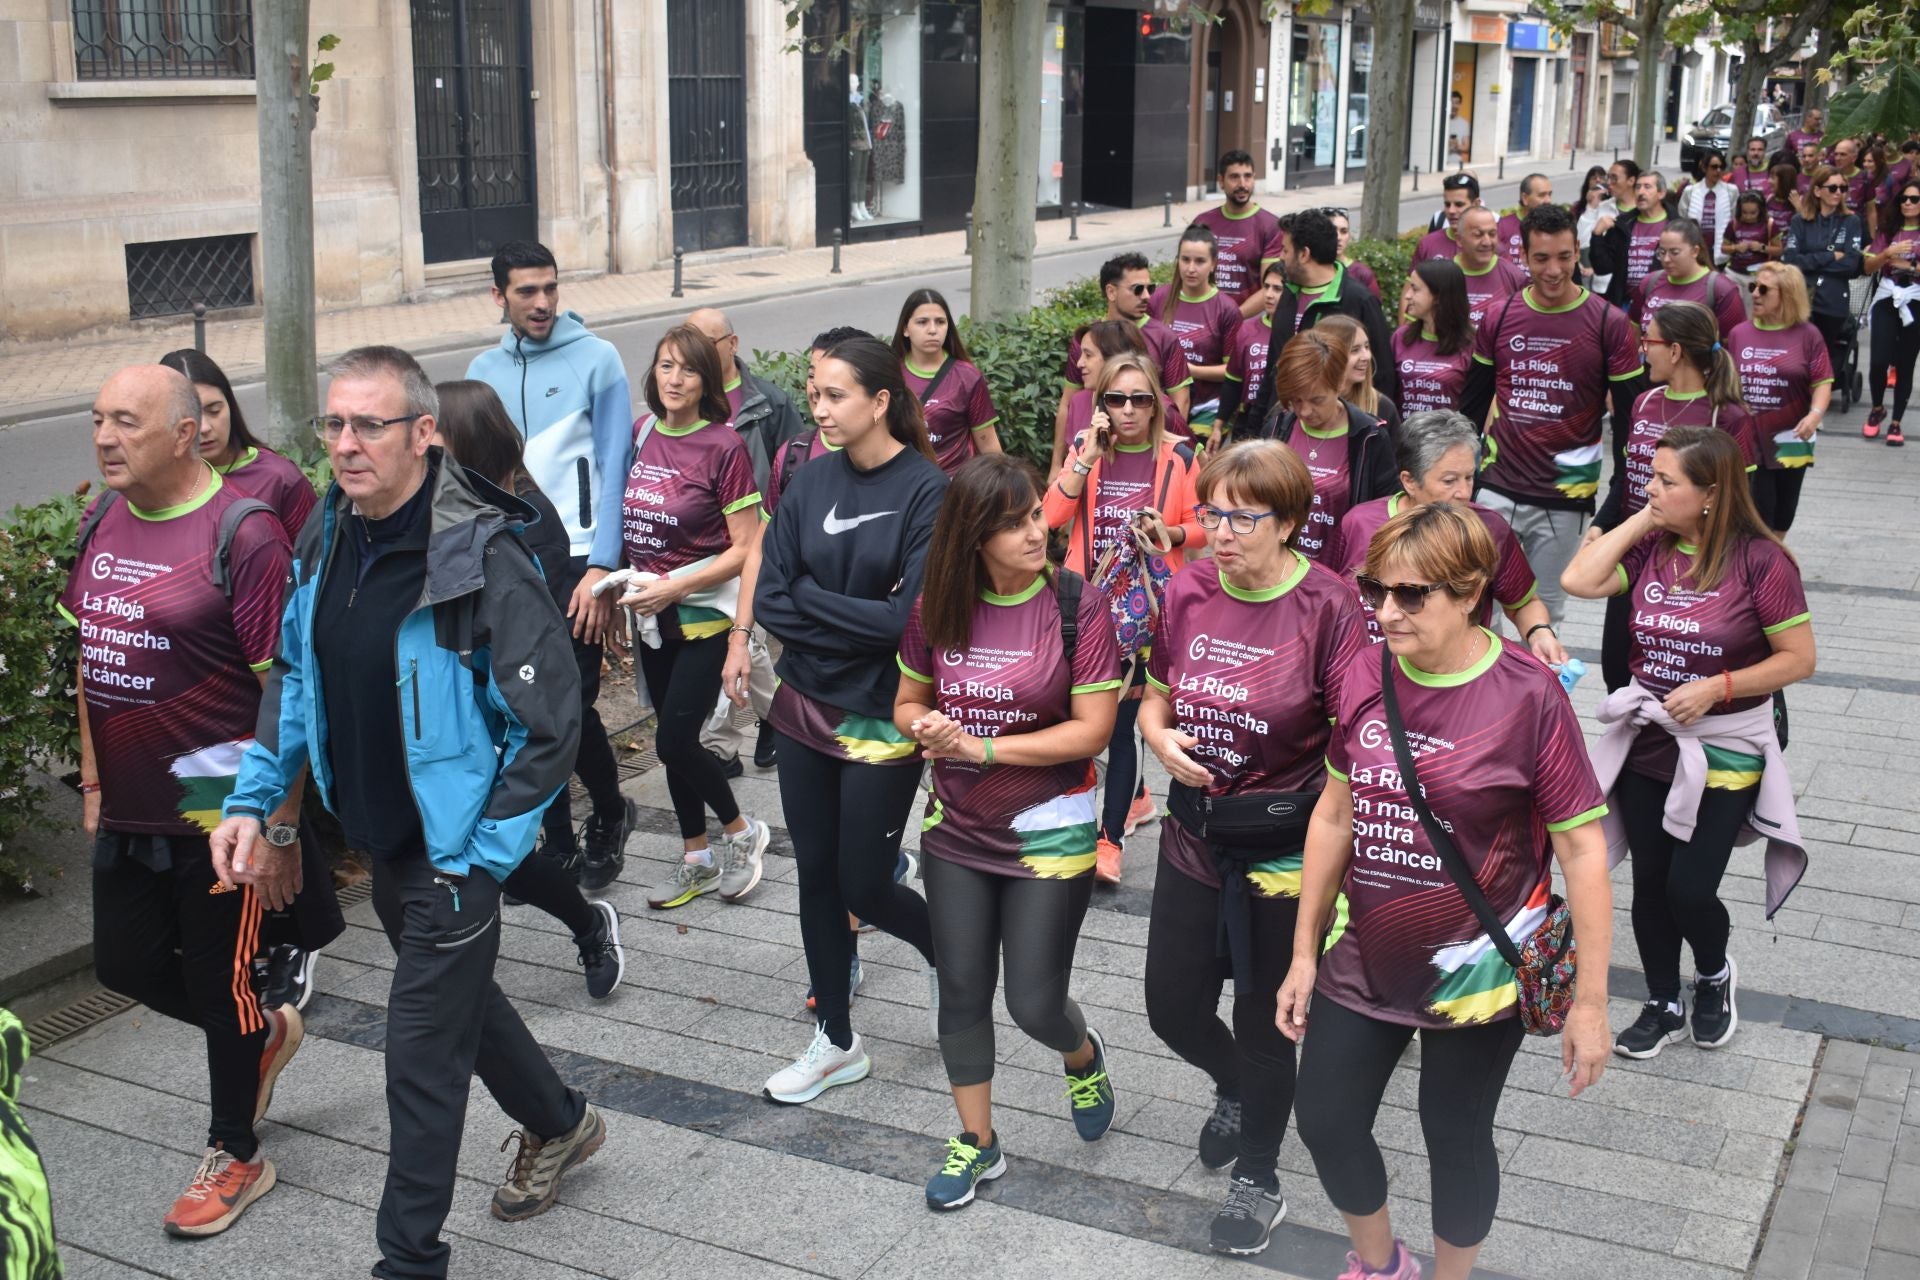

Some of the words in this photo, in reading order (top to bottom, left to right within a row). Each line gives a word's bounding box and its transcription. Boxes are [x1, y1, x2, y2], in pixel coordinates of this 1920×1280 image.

[1180, 338, 1194, 349] oja
[1511, 360, 1525, 370] La
[1529, 360, 1558, 374] Rioja
[1754, 364, 1777, 375] Rioja
[1402, 380, 1413, 388] La
[1416, 380, 1441, 391] Rioja
[1511, 375, 1525, 385] En
[1529, 379, 1573, 391] marcha
[1754, 377, 1788, 387] marcha
[1404, 392, 1414, 400] En
[1417, 394, 1451, 404] marcha
[1512, 388, 1547, 400] contra
[1402, 403, 1432, 411] contra
[1509, 398, 1520, 408] el
[1522, 400, 1564, 414] cáncer
[1627, 441, 1636, 453] La
[1640, 444, 1656, 457] Rio
[625, 487, 633, 498] La
[636, 488, 664, 505] Rioja
[633, 507, 678, 526] marcha
[1308, 512, 1334, 525] rcha
[624, 530, 632, 540] el
[633, 532, 668, 548] cáncer
[1298, 536, 1322, 549] ncer
[117, 558, 146, 567] asociación
[146, 562, 172, 573] española
[83, 592, 102, 611] La
[106, 596, 145, 622] Rioja
[1368, 621, 1378, 630] n
[1636, 611, 1654, 626] La
[1658, 614, 1700, 634] Rioja
[81, 618, 98, 638] En
[101, 627, 170, 650] marcha
[970, 646, 1004, 655] asociación
[1212, 638, 1246, 650] asociación
[1247, 645, 1274, 656] española
[1636, 632, 1656, 646] En
[1660, 637, 1722, 656] marcha
[82, 644, 126, 666] contra
[1210, 646, 1230, 655] contra
[1239, 650, 1260, 661] cáncer
[1226, 656, 1243, 666] Rioja
[1643, 649, 1686, 667] contra
[1643, 661, 1654, 674] el
[82, 662, 90, 679] el
[92, 666, 156, 690] cáncer
[940, 678, 960, 696] La
[966, 681, 1014, 702] Rioja
[1179, 673, 1198, 691] La
[1202, 677, 1248, 703] Rioja
[968, 706, 1038, 724] marcha
[1176, 698, 1194, 718] En
[1200, 706, 1268, 735] marcha
[960, 722, 1000, 737] ntra
[1428, 737, 1455, 750] española
[1351, 762, 1372, 784] La
[1352, 817, 1414, 844] contra
[1370, 870, 1396, 879] ESPAÑOLA
[1397, 876, 1415, 884] CONTRA
